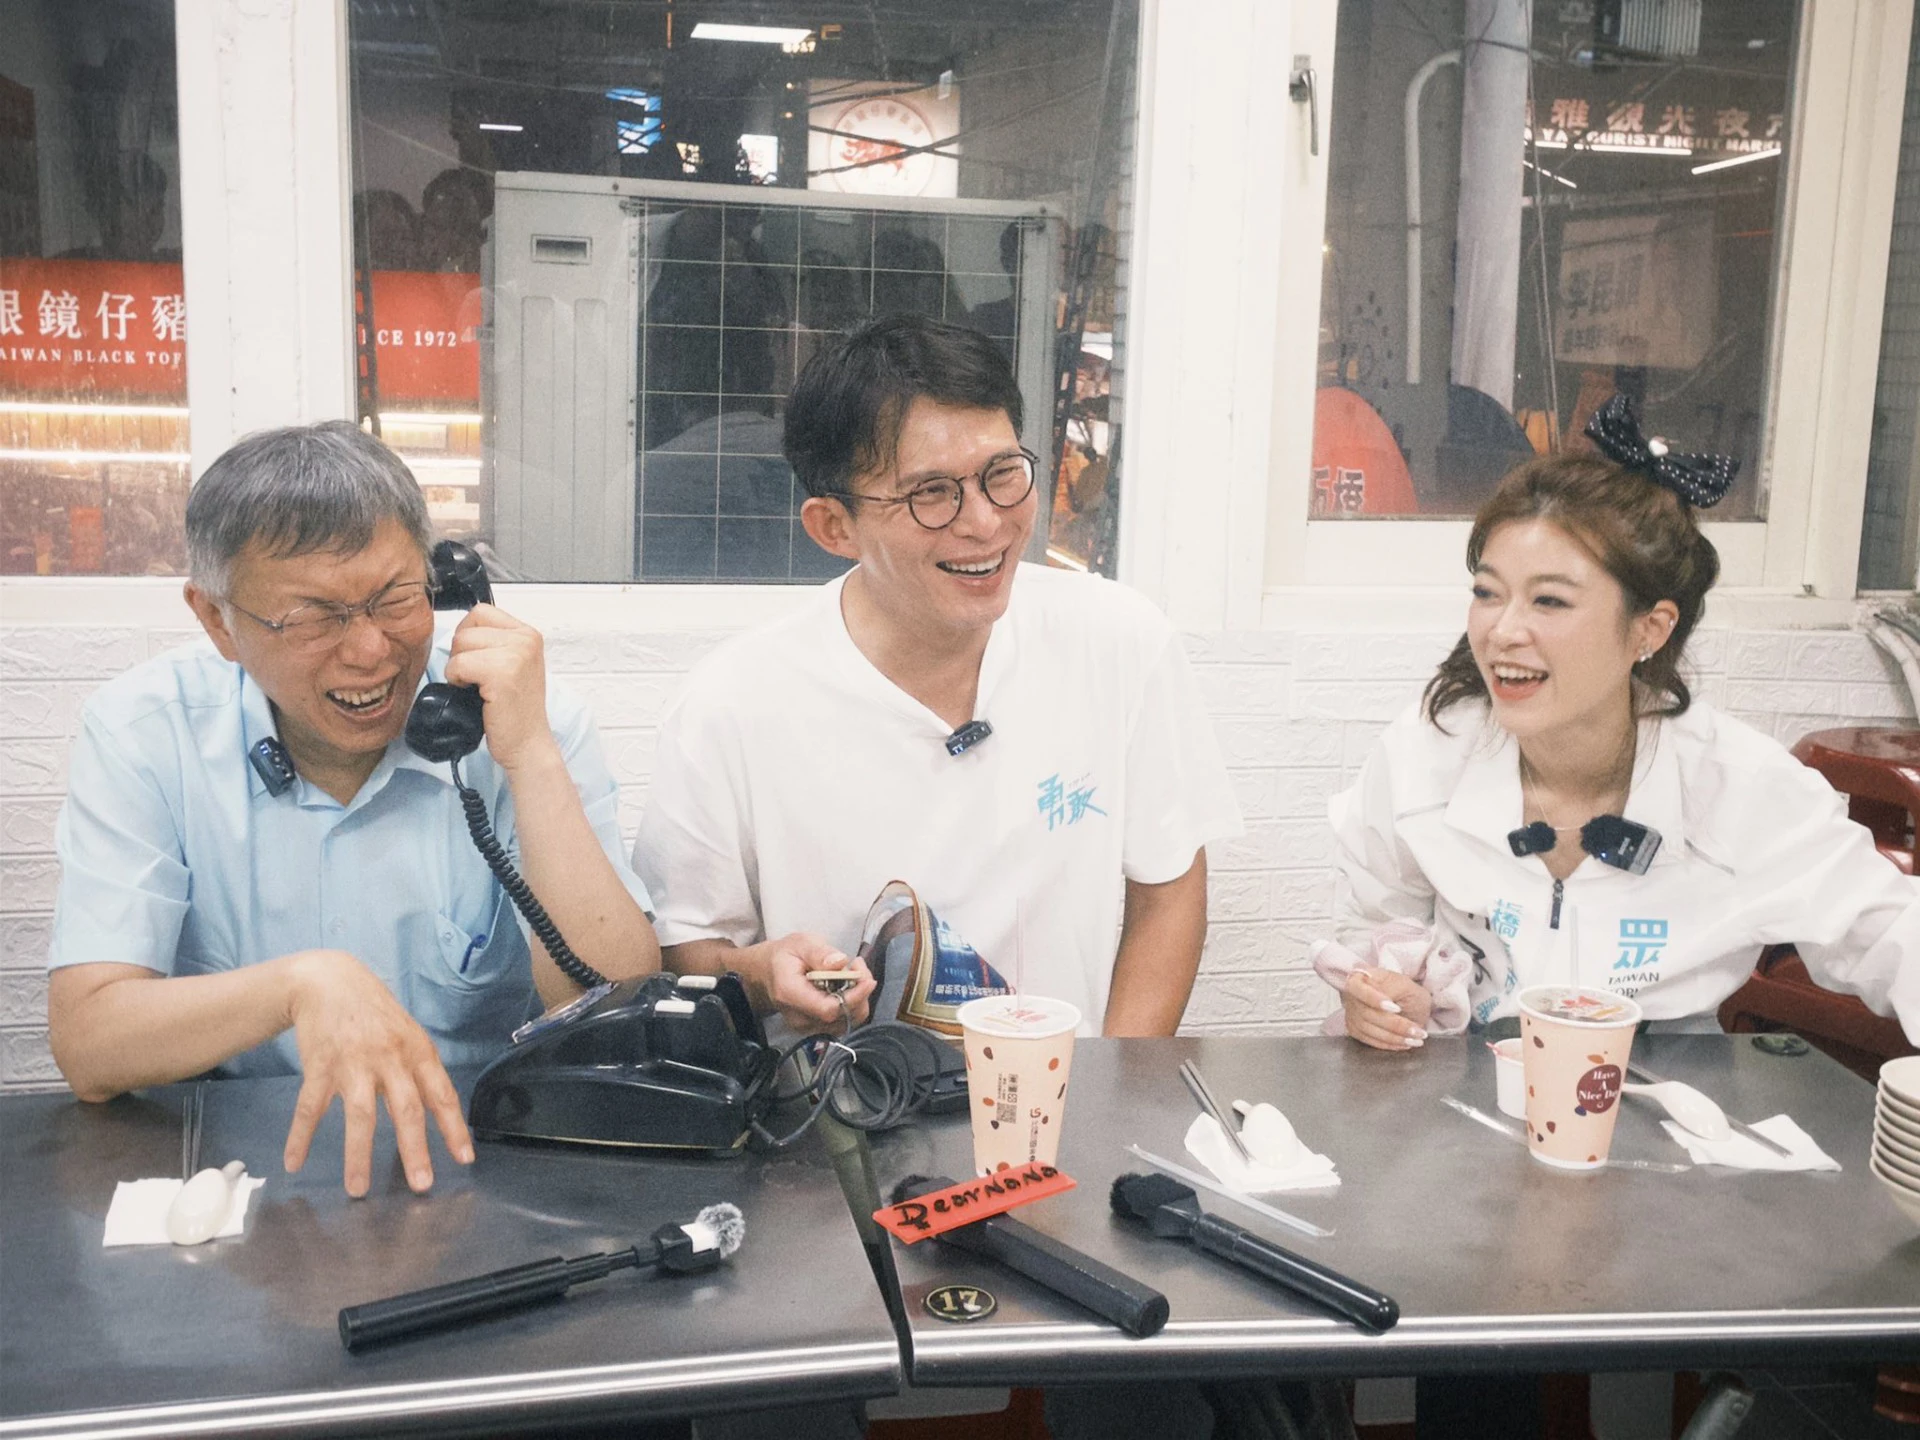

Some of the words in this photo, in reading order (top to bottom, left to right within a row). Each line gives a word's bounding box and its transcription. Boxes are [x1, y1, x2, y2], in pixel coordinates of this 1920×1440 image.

[414, 330, 457, 347] 1972
[73, 350, 136, 364] BLACK
[1608, 972, 1660, 985] TAIWAN
[1592, 1070, 1616, 1080] Have
[1579, 1090, 1603, 1100] Nice
[939, 1290, 982, 1313] 17
